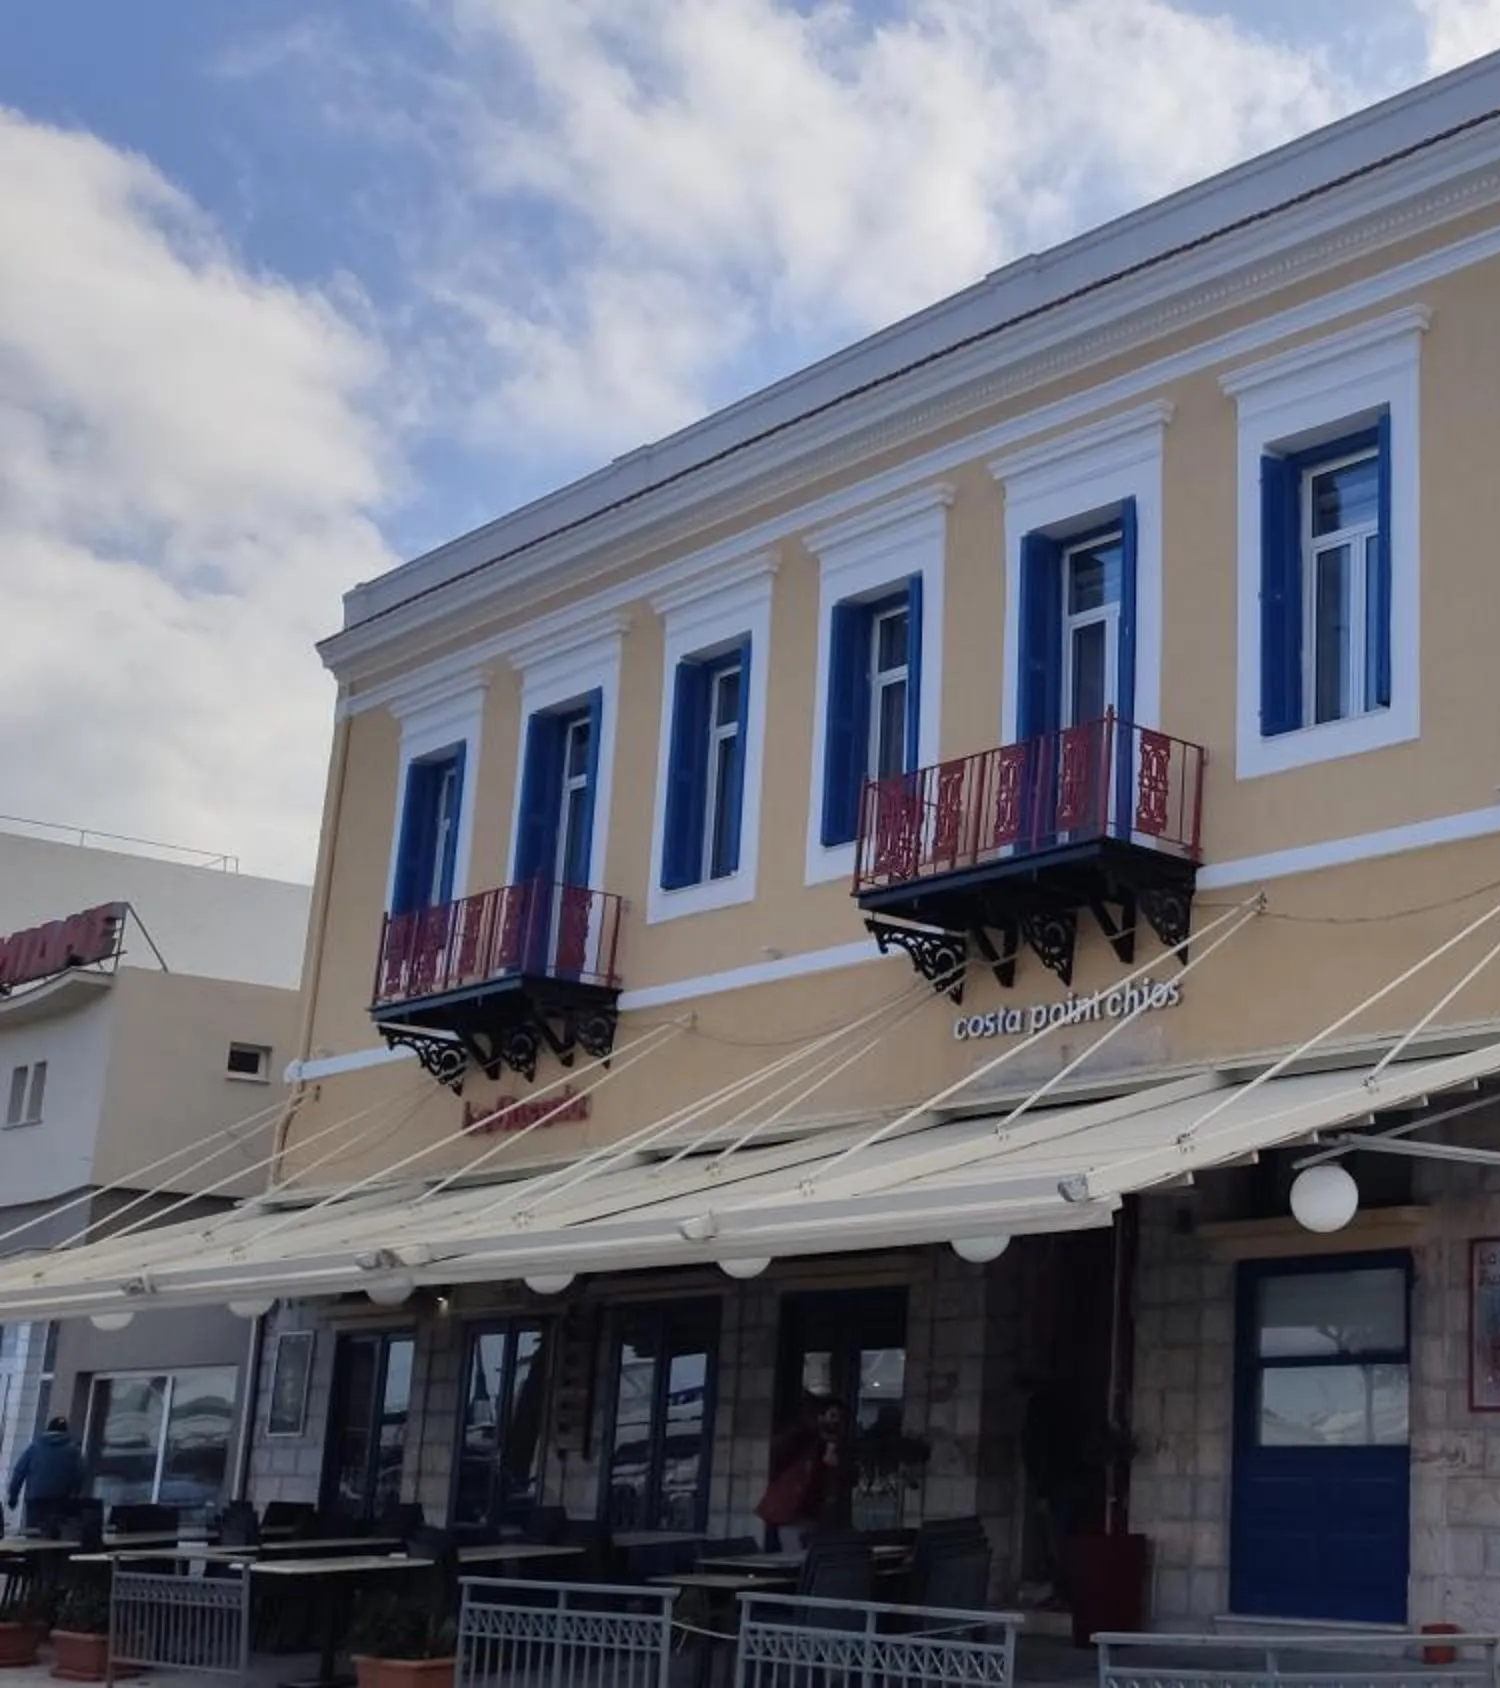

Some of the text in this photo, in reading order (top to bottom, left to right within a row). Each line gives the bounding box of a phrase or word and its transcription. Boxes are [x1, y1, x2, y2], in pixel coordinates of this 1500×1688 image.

[953, 978, 1182, 1040] costa point chios
